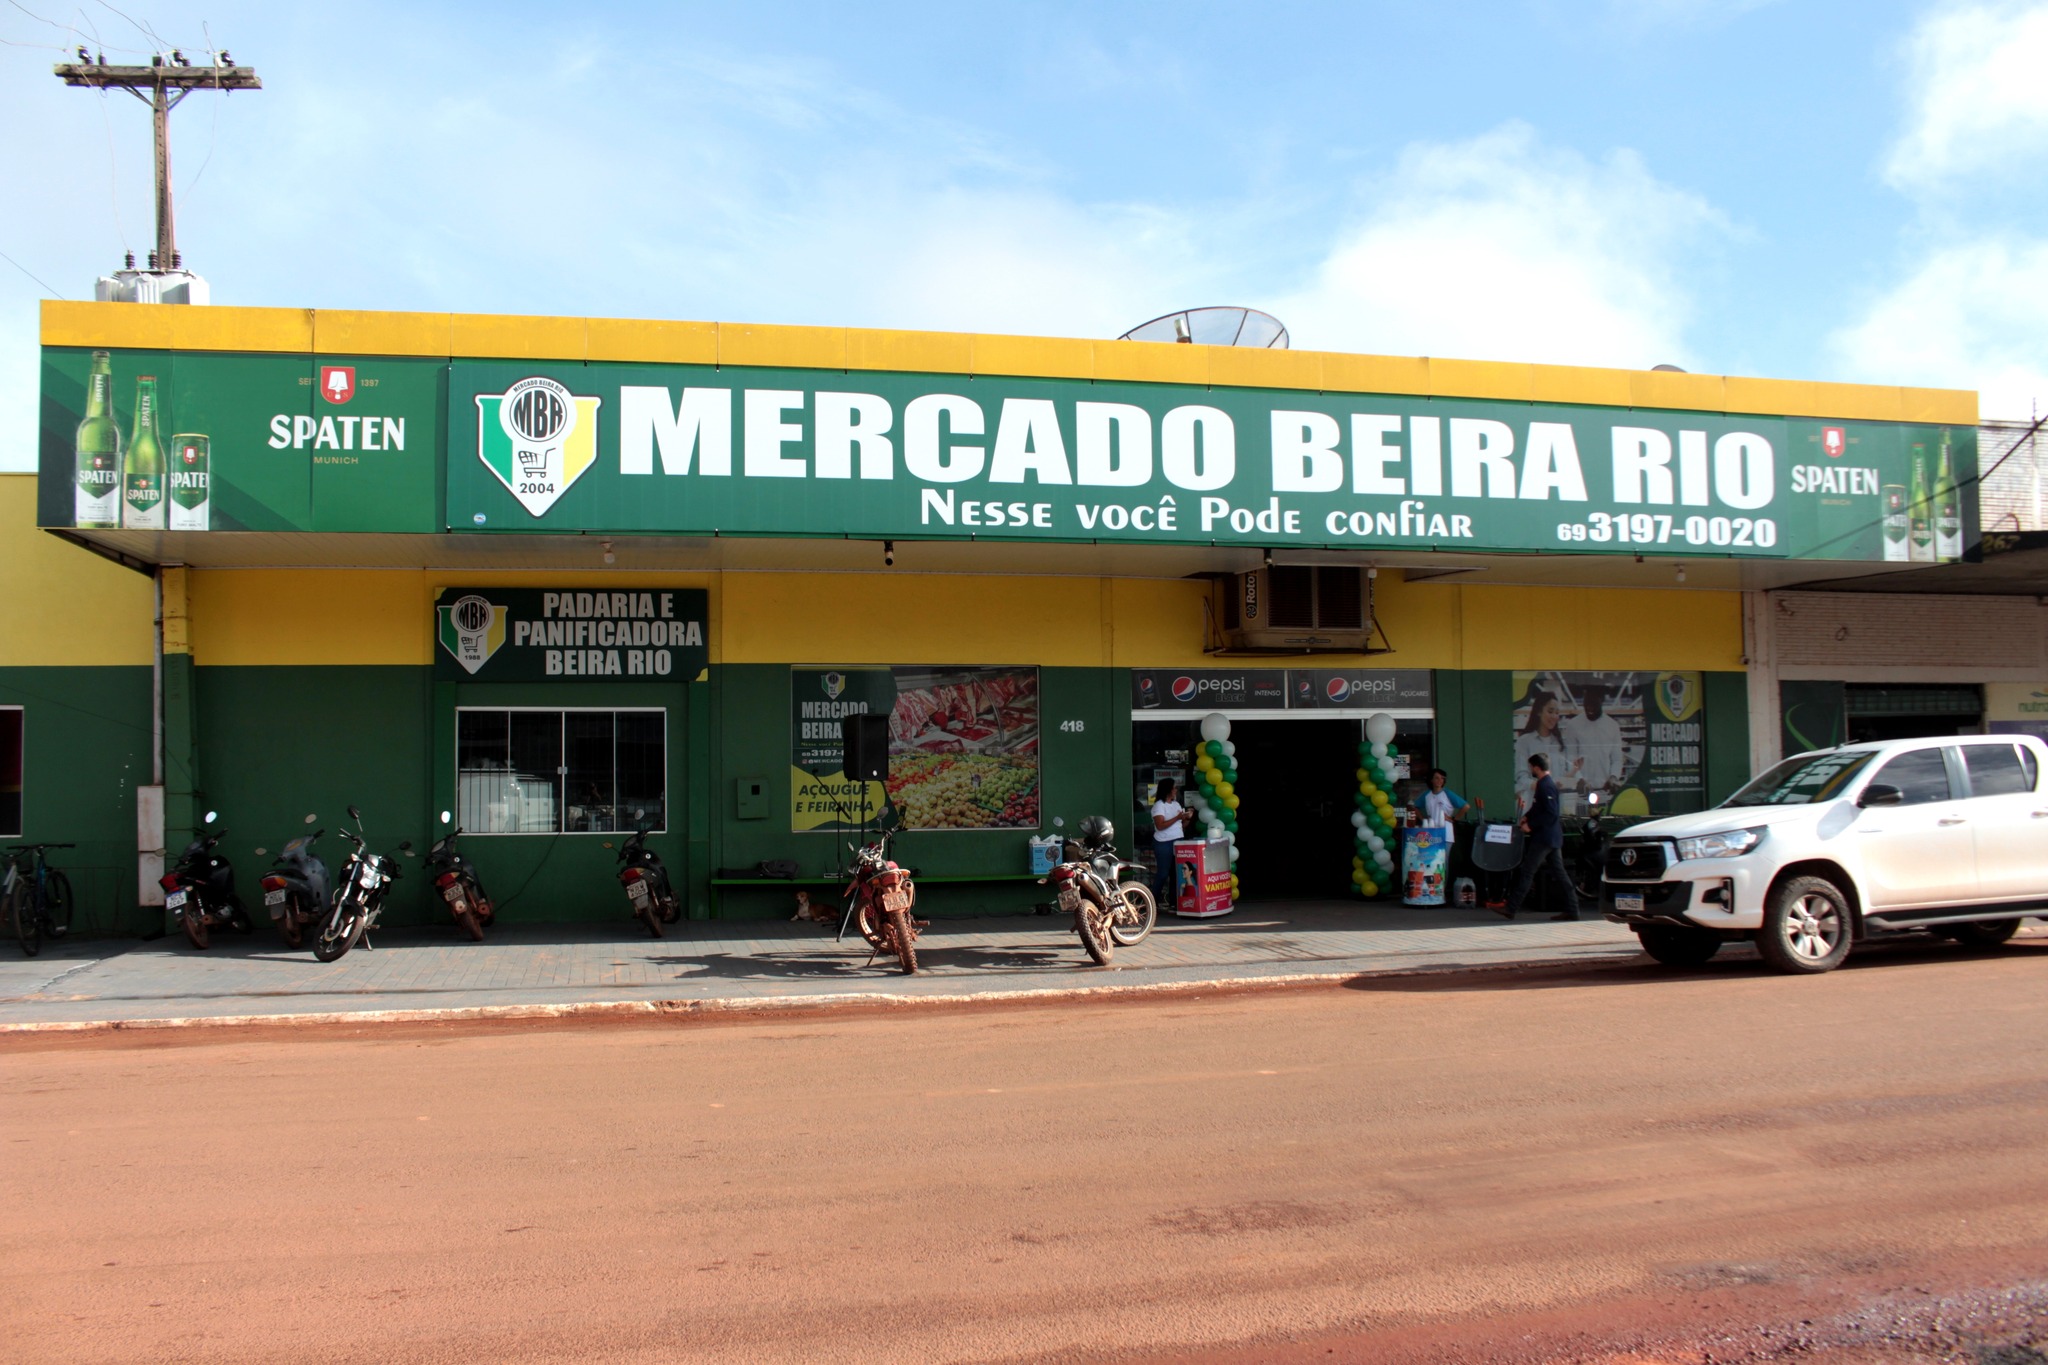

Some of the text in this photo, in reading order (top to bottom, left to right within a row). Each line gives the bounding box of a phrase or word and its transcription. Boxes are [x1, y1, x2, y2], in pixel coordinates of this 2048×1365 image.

[513, 379, 564, 394] MERCADO BEIRA RIO
[514, 390, 563, 438] MBR
[268, 414, 405, 451] SPATEN
[620, 385, 1775, 510] MERCADO BEIRA RIO
[313, 456, 359, 465] MUNICH
[79, 470, 118, 484] SPATEN
[170, 471, 209, 488] SPATE
[1791, 464, 1879, 495] SPATEN
[127, 489, 160, 501] SPATEN
[519, 482, 555, 494] 2004
[543, 592, 674, 618] PADARIA E
[459, 602, 486, 629] MBR
[514, 621, 702, 646] PANIFICADORA
[545, 649, 672, 675] BEIRA RIO
[1198, 676, 1245, 694] pepsi
[1351, 678, 1396, 694] pepsi
[1216, 693, 1246, 702] BLACK
[801, 701, 869, 718] MERCADO
[801, 722, 843, 739] BEIRA
[1060, 720, 1084, 732] 418
[1651, 723, 1700, 742] MERCADO
[1650, 746, 1700, 765] BEIRA RIO
[799, 784, 870, 798] AÇOUGUE
[795, 802, 803, 812] E
[1207, 875, 1219, 883] AQUI
